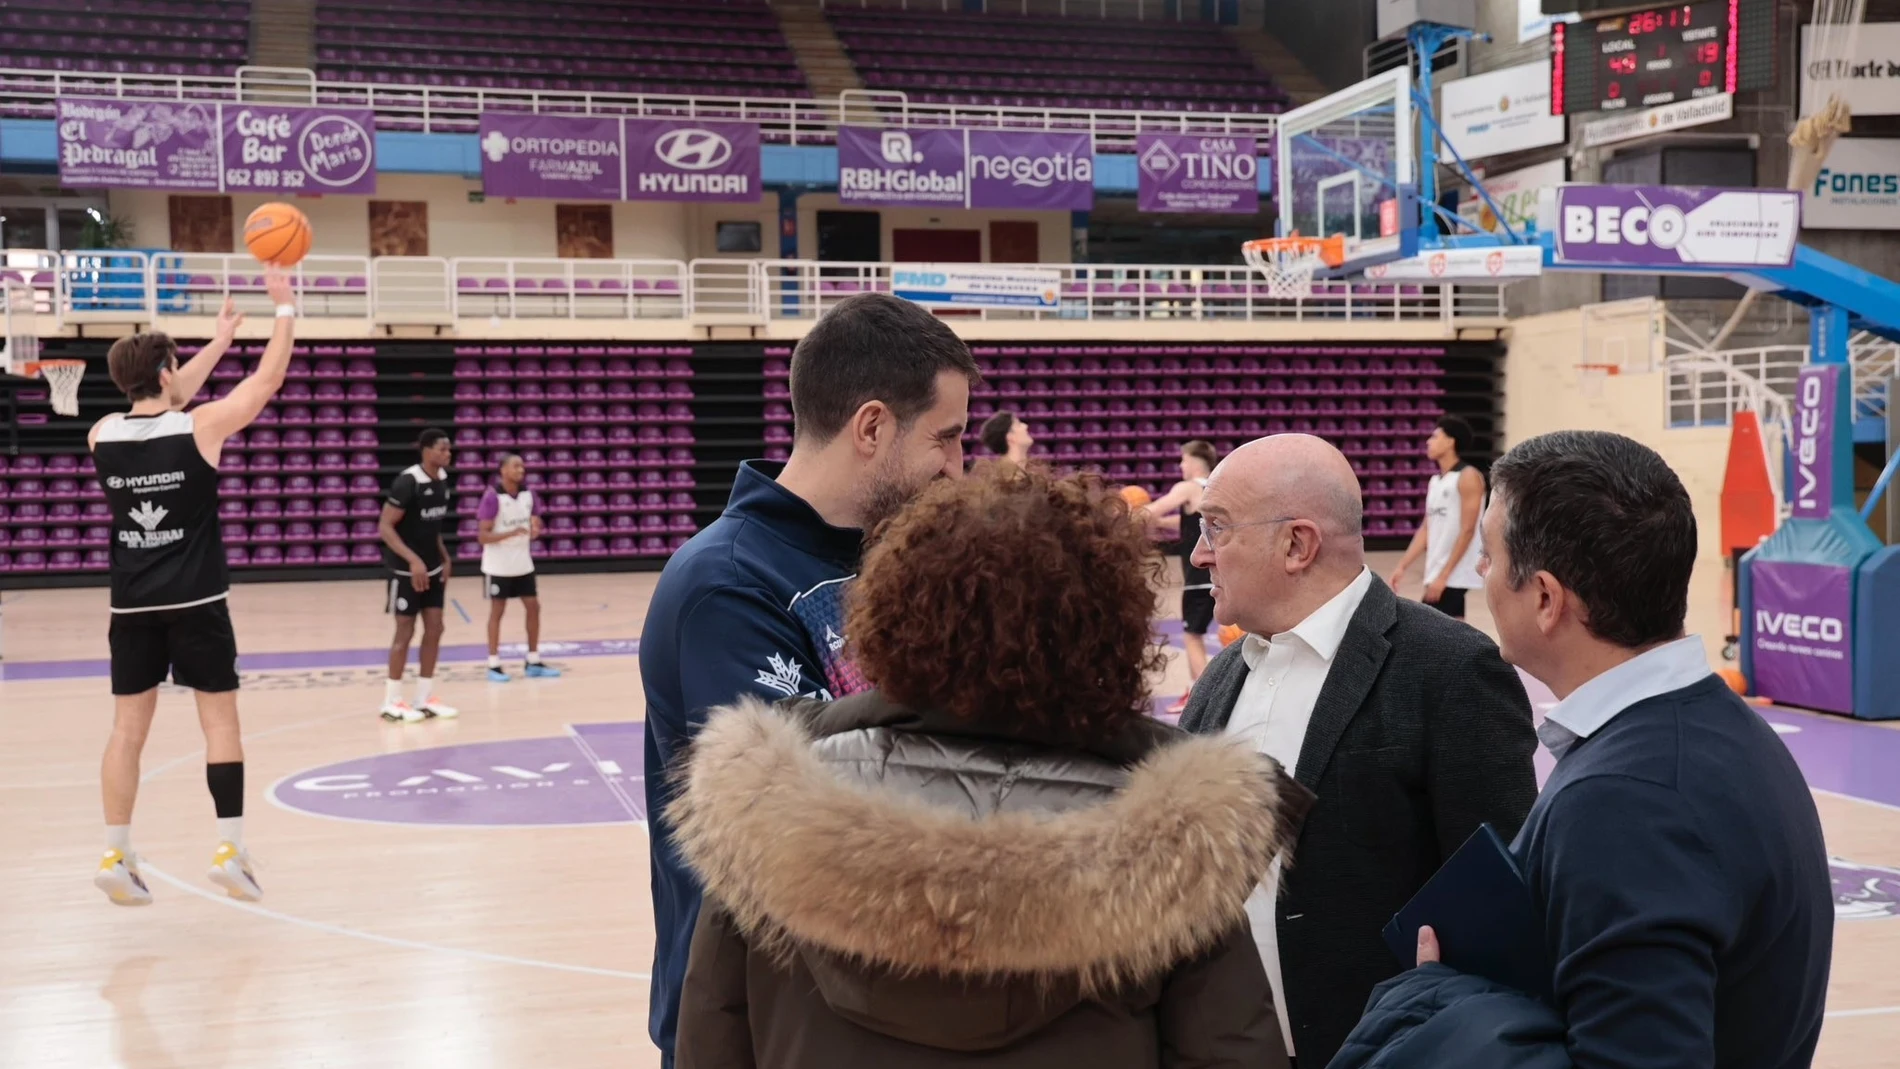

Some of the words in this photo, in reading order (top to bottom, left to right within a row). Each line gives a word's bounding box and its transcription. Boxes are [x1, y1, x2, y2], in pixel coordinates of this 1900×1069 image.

[1602, 39, 1636, 54] LOCAL
[1676, 101, 1727, 121] Valladolid
[60, 120, 87, 141] El
[236, 110, 291, 141] Café
[309, 124, 360, 152] Donde
[62, 142, 159, 169] Pedragal
[242, 137, 288, 164] Bar
[510, 137, 619, 157] ORTOPEDIA
[1200, 138, 1237, 152] CASA
[529, 158, 603, 175] FARMAZUL
[970, 152, 1093, 187] negotia
[1180, 153, 1256, 180] TINO
[639, 173, 748, 194] HYUNDAI
[840, 167, 964, 193] RBHGlobal
[1564, 203, 1687, 249] BECO
[893, 272, 947, 286] FMD
[1799, 376, 1821, 509] IVECO
[125, 470, 185, 488] HYUNDAI
[1756, 609, 1843, 642] IVECO
